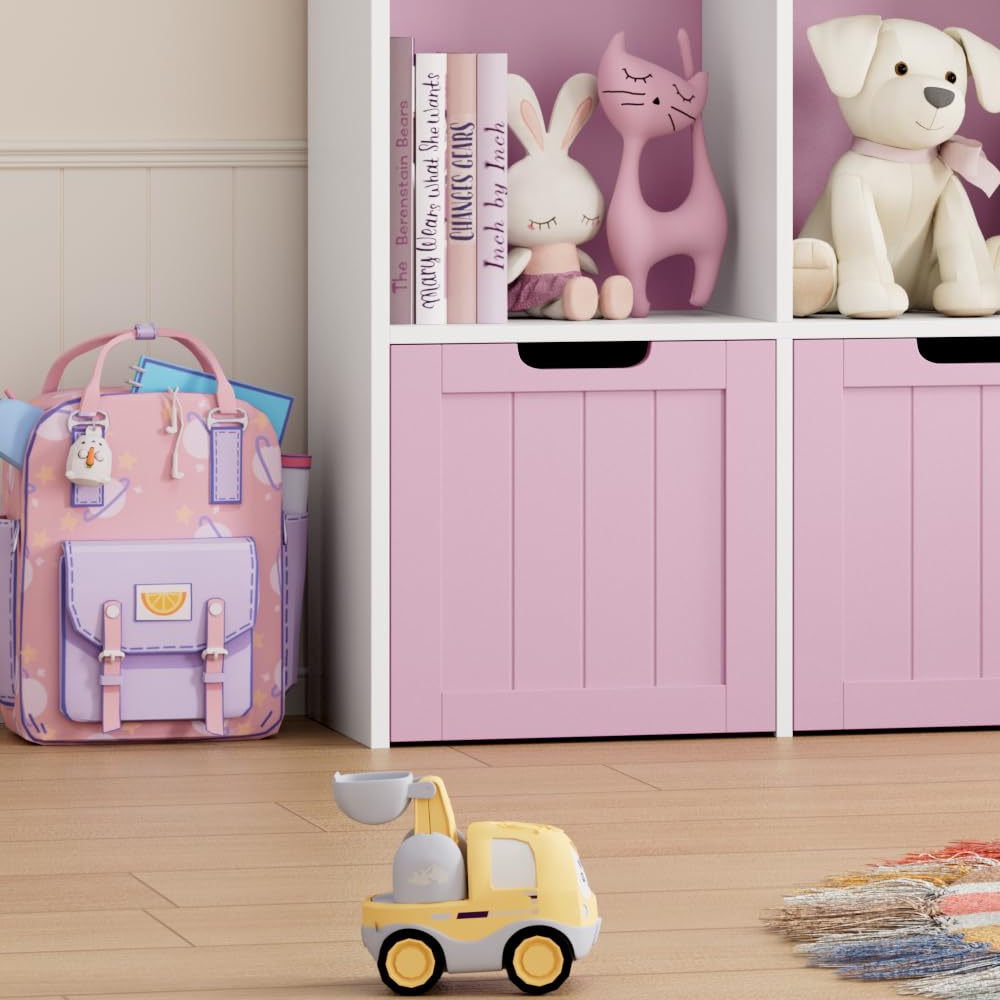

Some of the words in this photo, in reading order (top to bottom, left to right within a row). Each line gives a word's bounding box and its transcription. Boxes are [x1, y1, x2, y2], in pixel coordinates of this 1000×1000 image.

[395, 100, 409, 148] Bears
[419, 127, 439, 151] She
[449, 121, 475, 169] GEARS
[483, 121, 505, 172] Inch
[395, 155, 409, 245] Berenstain
[449, 174, 475, 241] CHANGES
[483, 183, 507, 208] by
[483, 220, 505, 270] Inch
[392, 261, 408, 294] The
